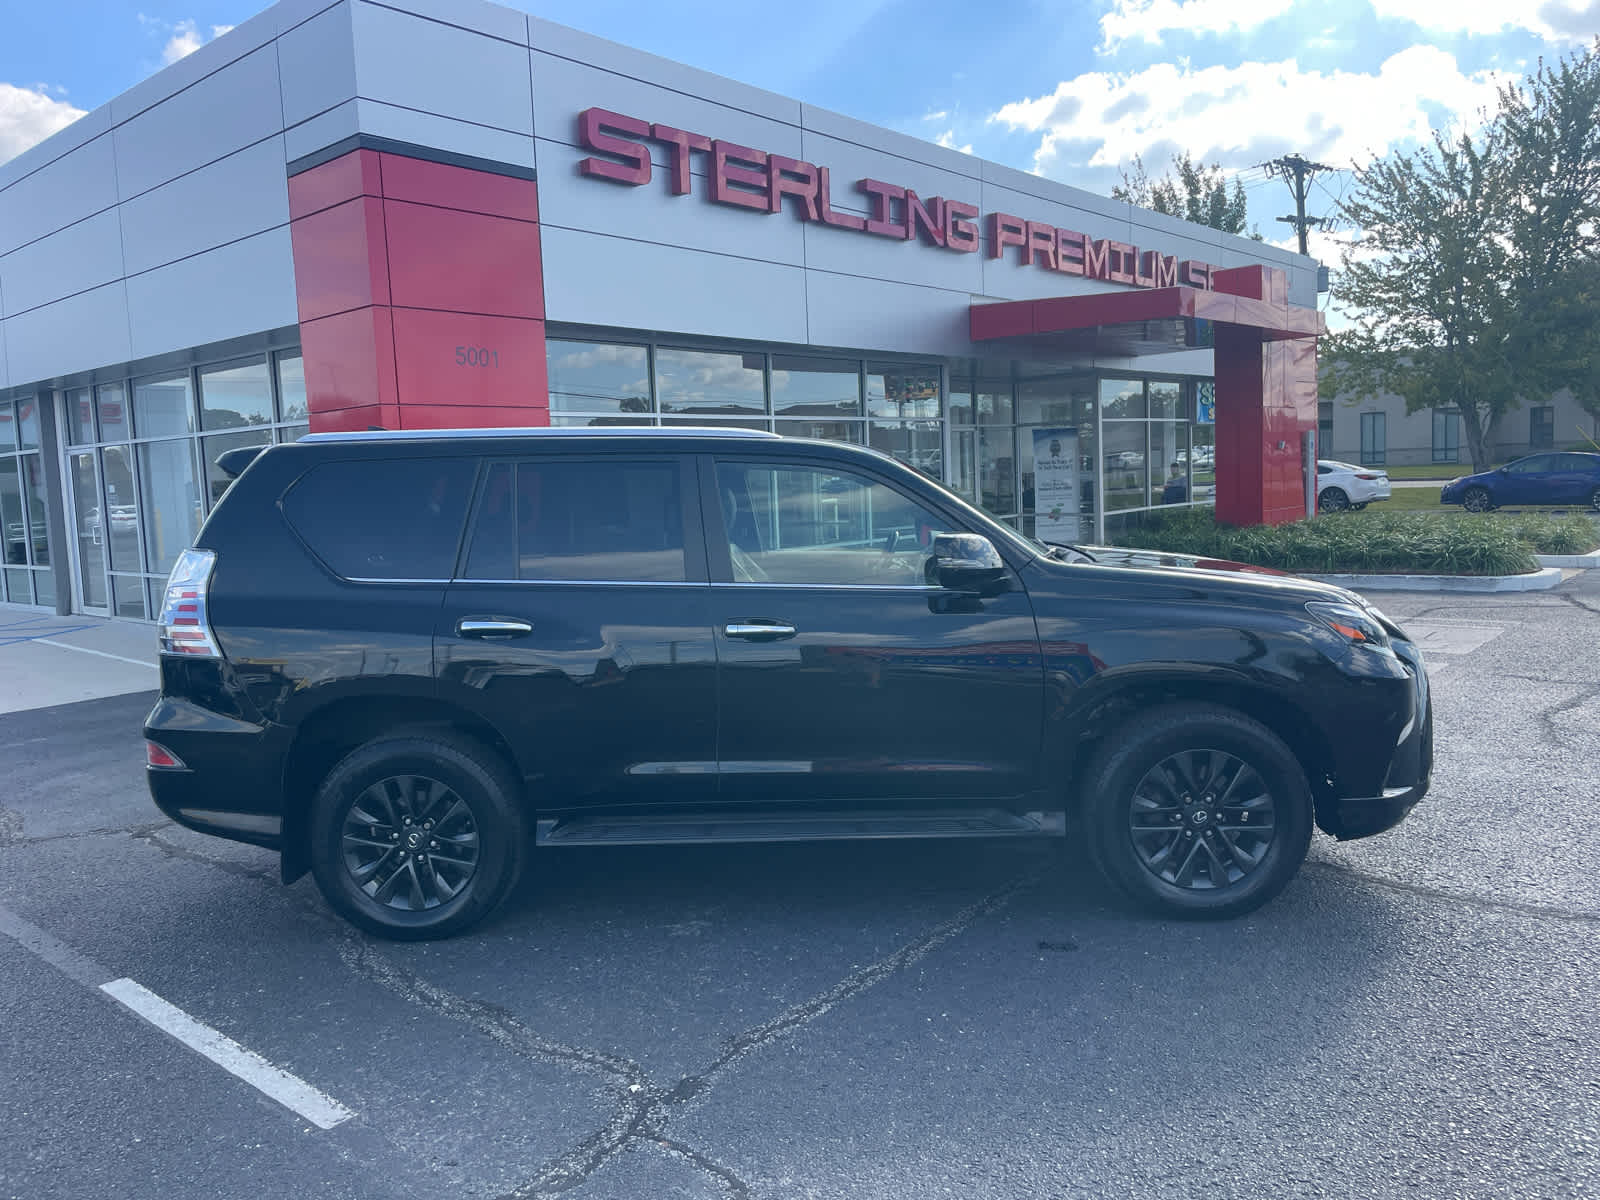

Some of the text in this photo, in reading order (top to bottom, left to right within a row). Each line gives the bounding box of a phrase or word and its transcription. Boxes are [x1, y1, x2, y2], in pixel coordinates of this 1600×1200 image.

[578, 107, 979, 253] STERLING
[988, 212, 1178, 289] PREMIUM
[455, 346, 499, 368] 5001
